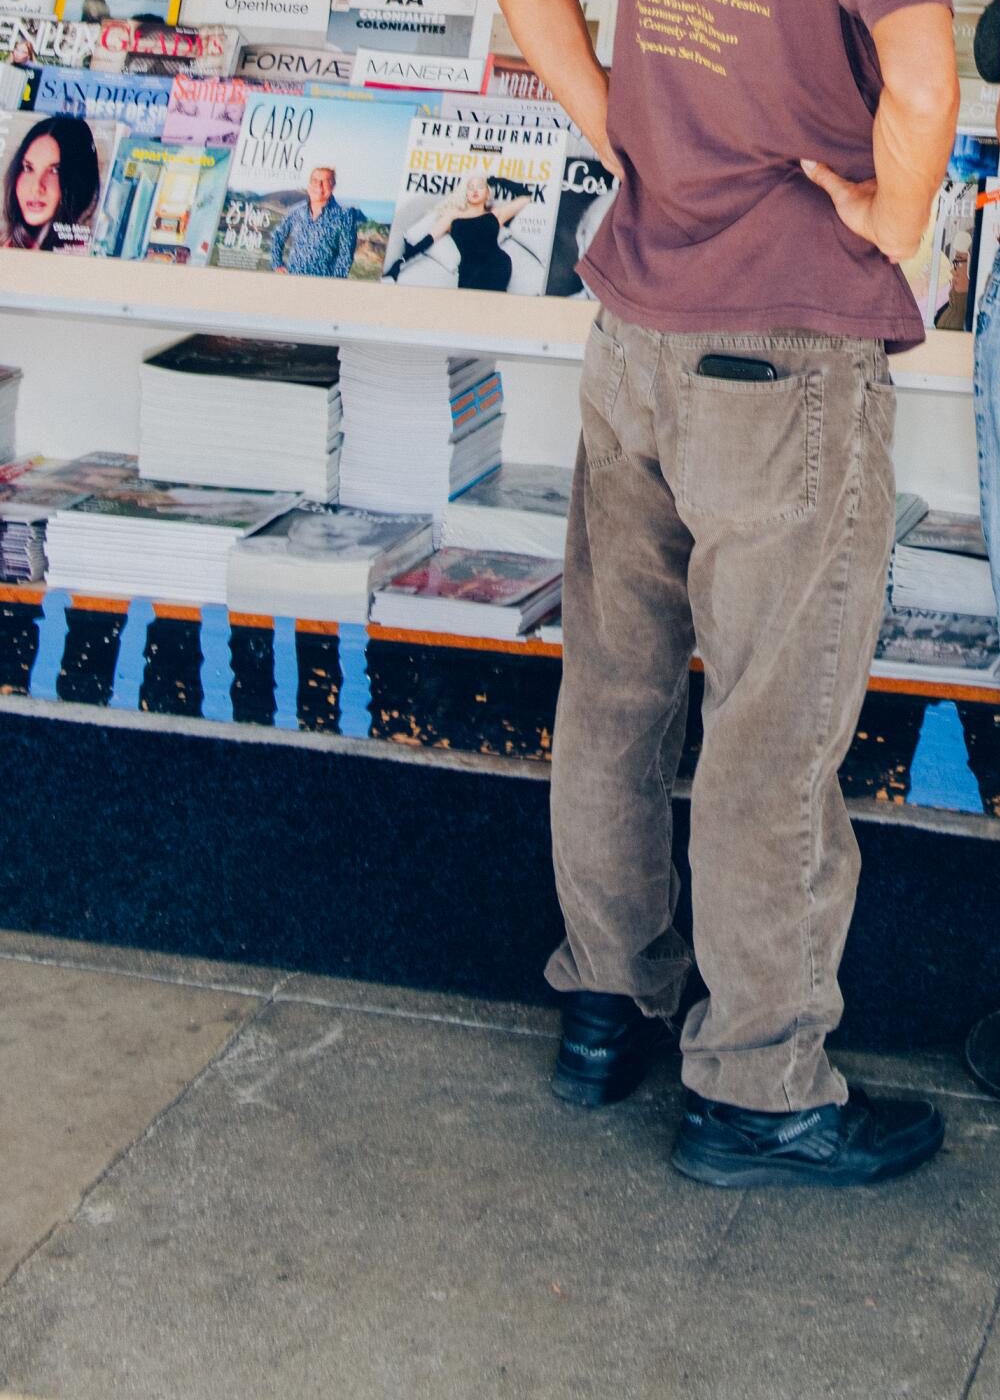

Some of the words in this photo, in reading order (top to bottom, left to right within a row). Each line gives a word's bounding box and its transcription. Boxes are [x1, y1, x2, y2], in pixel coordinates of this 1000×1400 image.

[101, 23, 224, 58] GLADYS
[356, 20, 446, 35] COLONIALITIES
[366, 58, 470, 83] MANERA
[42, 80, 89, 101] SAN
[95, 86, 171, 107] DIEGO
[249, 101, 314, 145] CABO
[421, 122, 451, 137] THE
[476, 127, 553, 146] JOURNAL
[240, 138, 305, 173] LIVING
[498, 157, 552, 181] HILLS
[777, 1112, 822, 1143] Reebok
